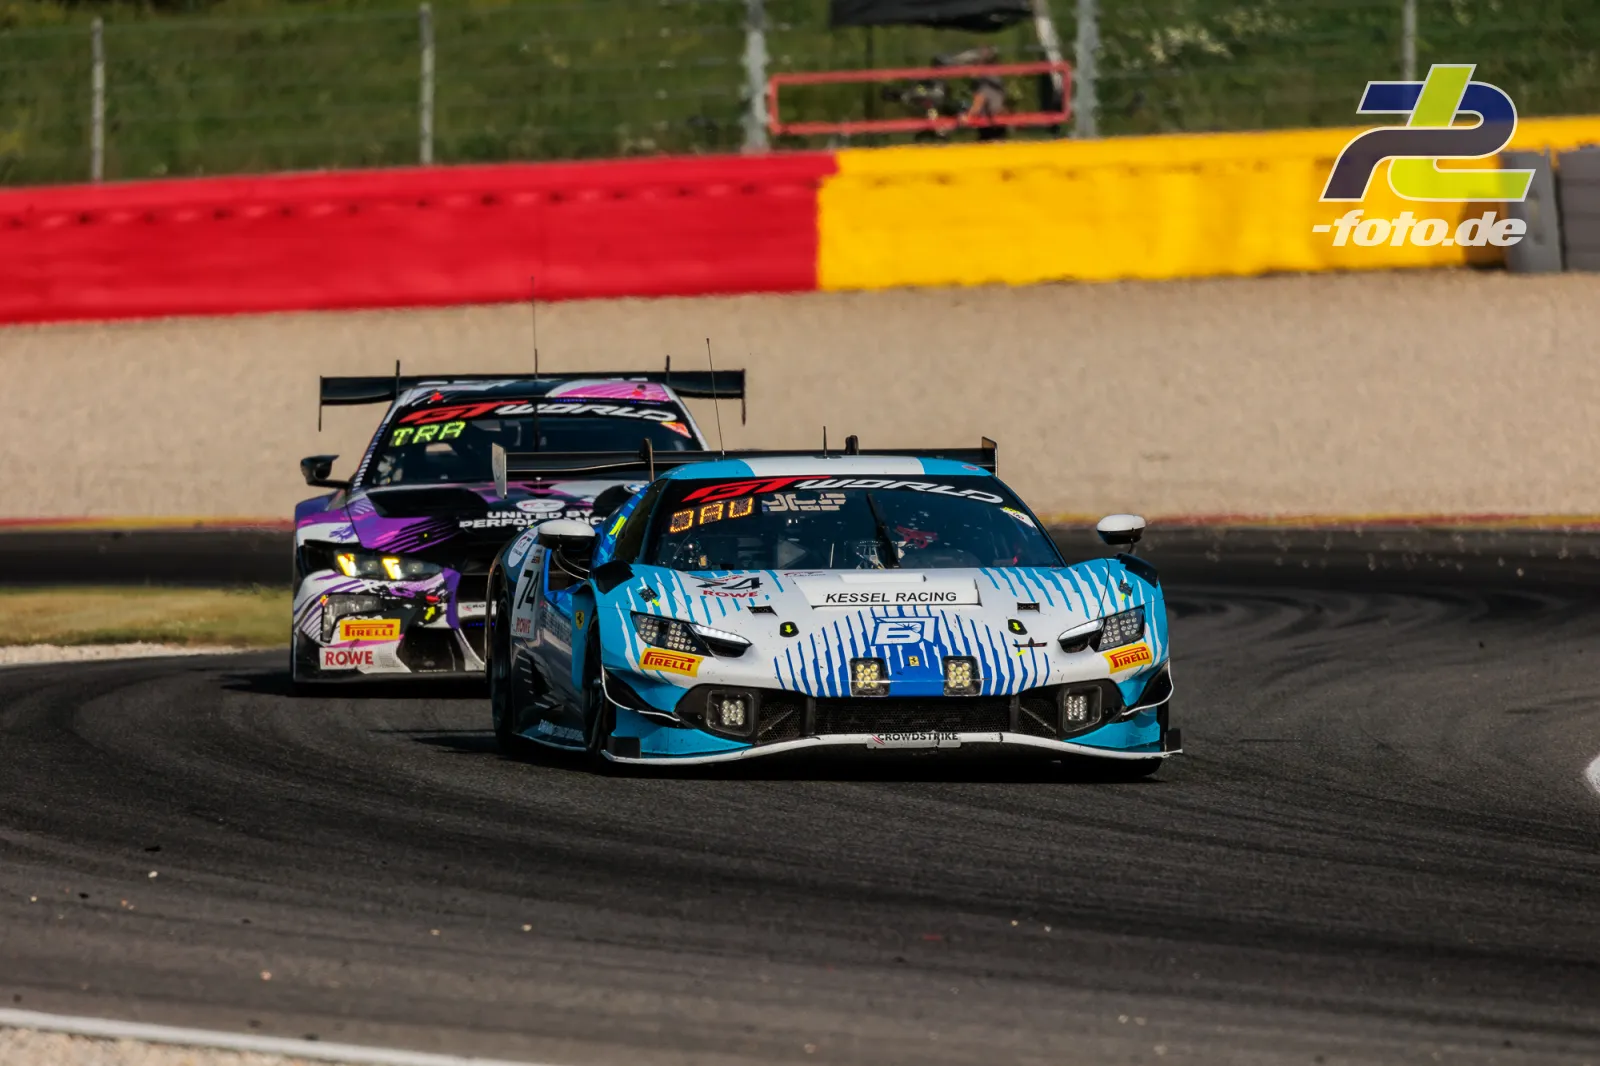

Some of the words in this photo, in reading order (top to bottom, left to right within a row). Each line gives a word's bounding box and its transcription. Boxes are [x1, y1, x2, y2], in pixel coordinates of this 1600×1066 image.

[399, 400, 528, 424] GT
[495, 403, 677, 422] WORLD
[389, 421, 466, 447] TRA
[681, 475, 832, 503] GT
[794, 479, 1003, 503] WORLD
[487, 511, 562, 520] UNITED
[566, 509, 594, 518] BY
[516, 569, 540, 612] 74
[702, 590, 758, 598] ROWE
[825, 592, 888, 603] KESSEL
[895, 591, 957, 602] RACING
[345, 624, 394, 636] PIRELLI
[325, 651, 374, 666] ROWE
[643, 651, 696, 672] PIRELLI
[1109, 646, 1150, 668] PIRELLI
[877, 732, 958, 742] CROWDSTRIKE
